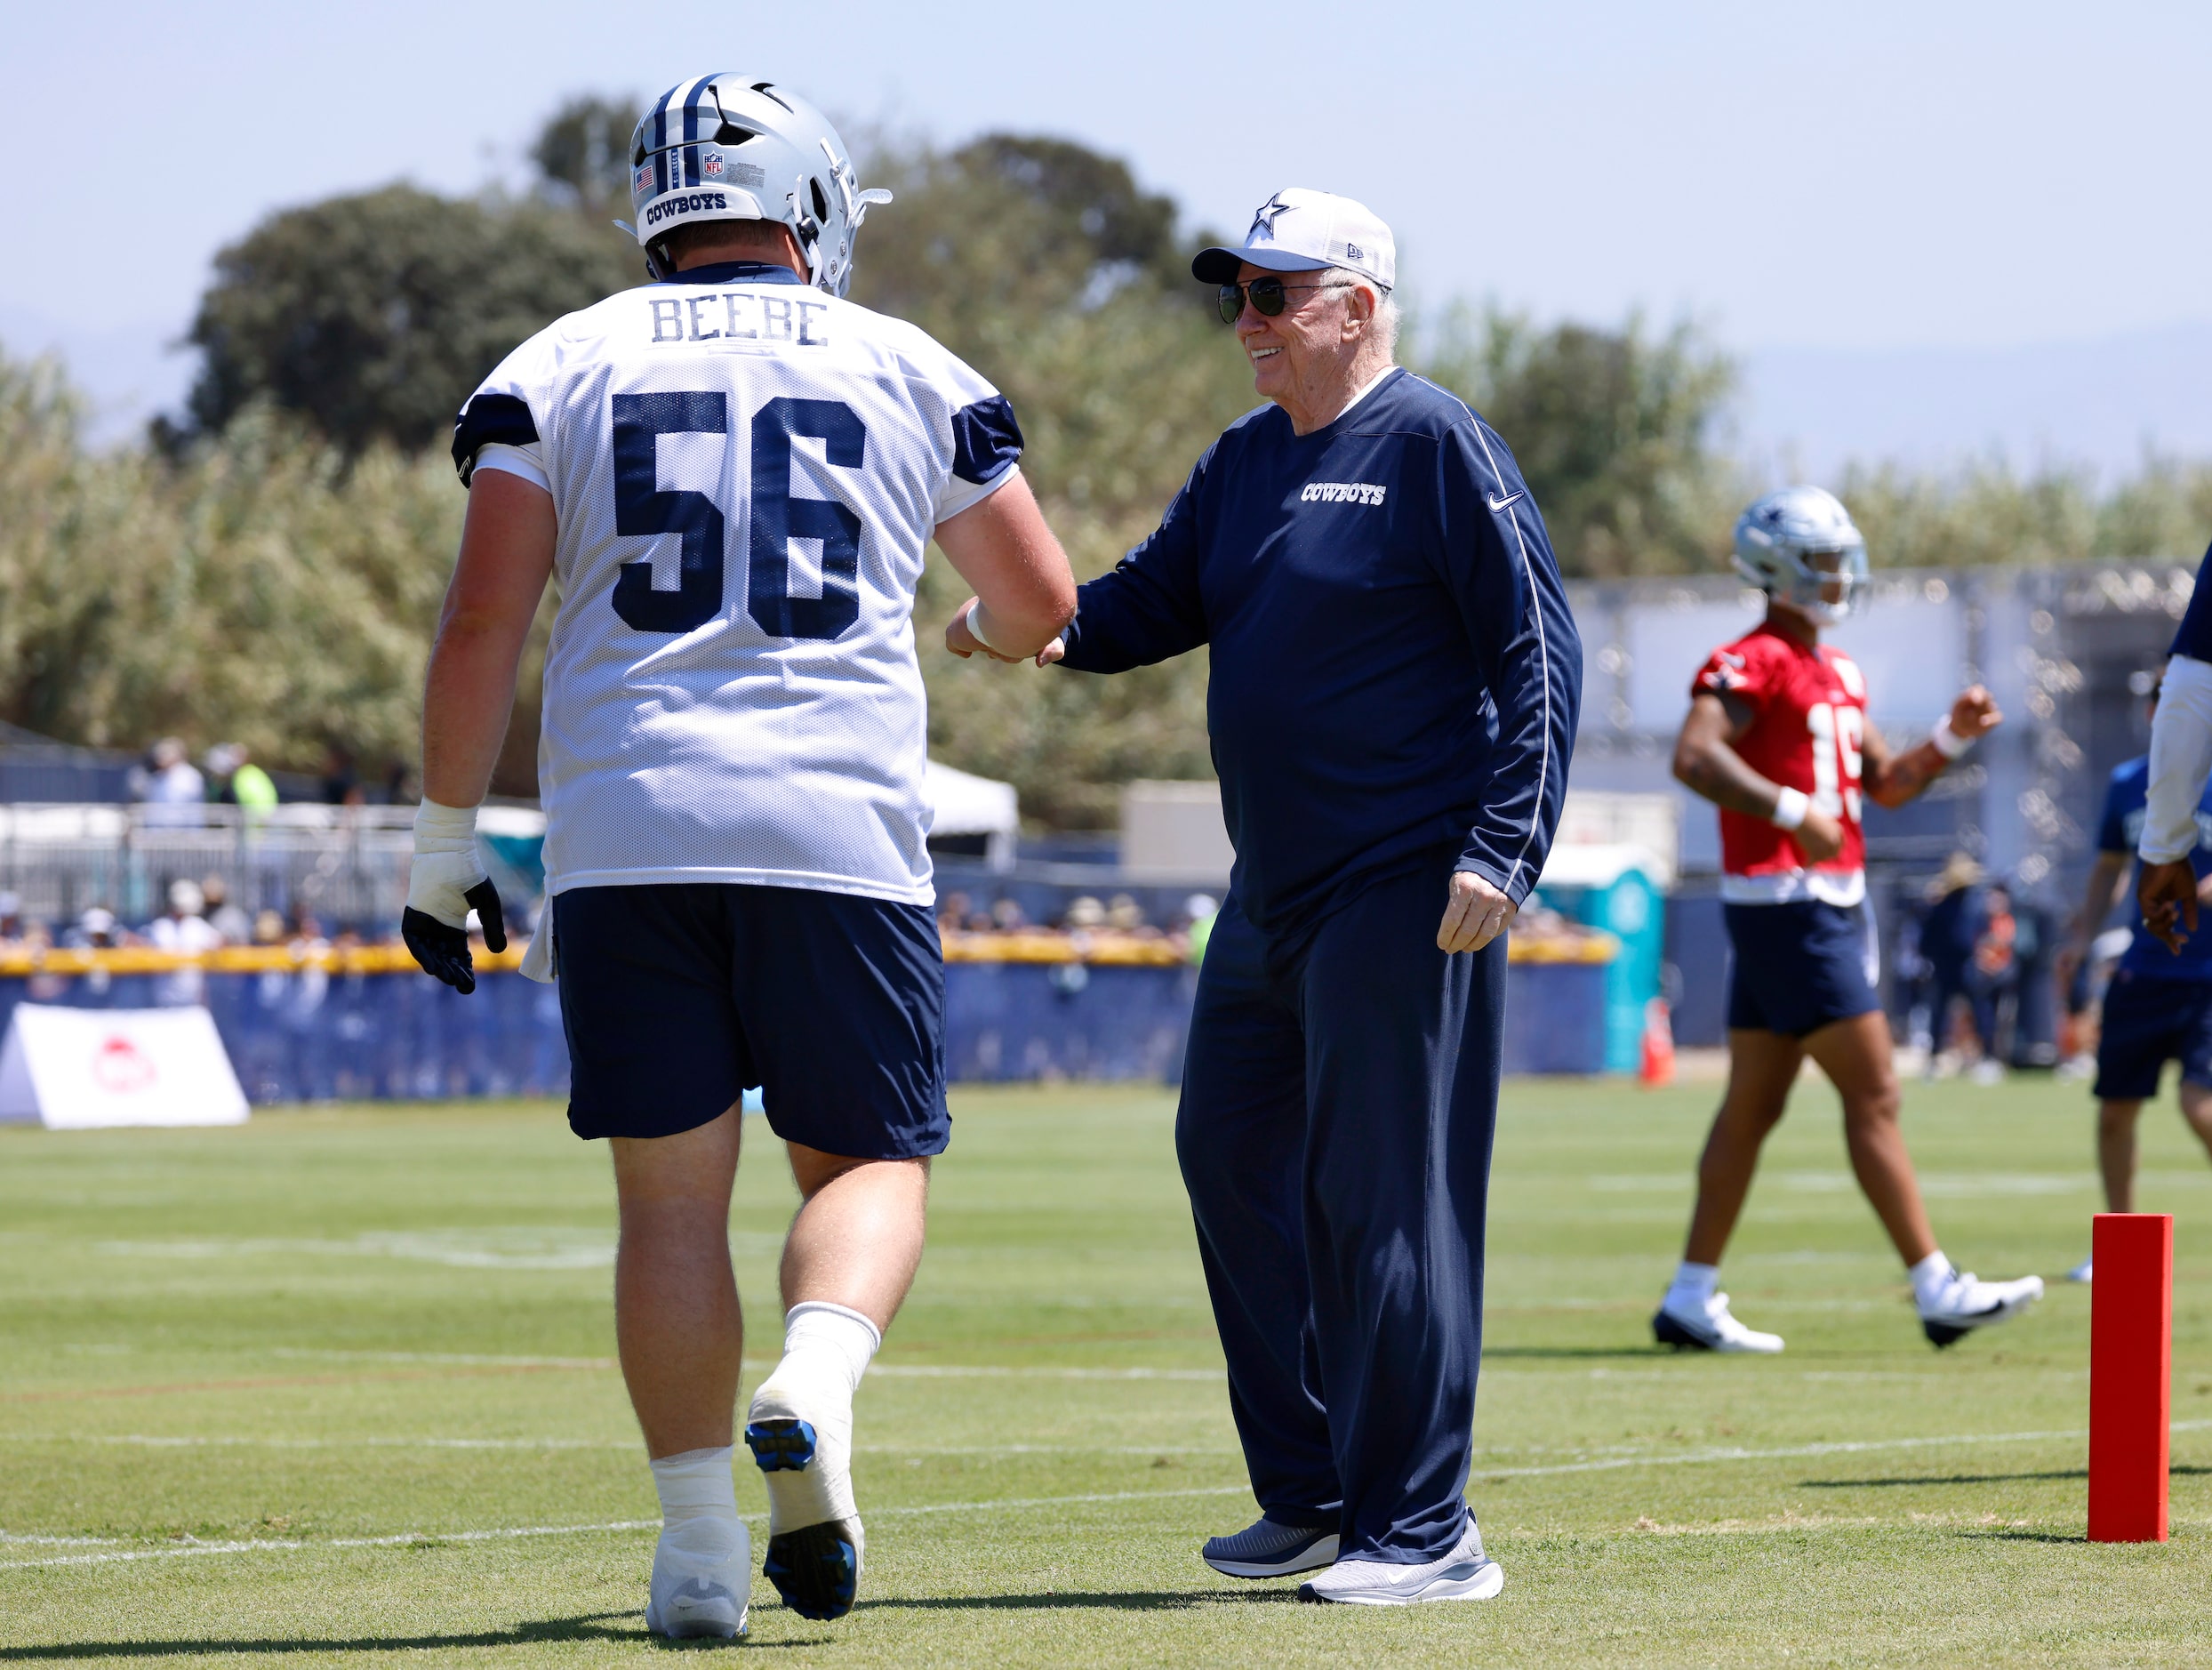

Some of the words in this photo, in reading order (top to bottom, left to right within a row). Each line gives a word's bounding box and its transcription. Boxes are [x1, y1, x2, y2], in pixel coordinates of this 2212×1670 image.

[706, 163, 722, 173] NFL
[646, 193, 727, 226] COWBOYS
[648, 293, 829, 347] BEEBE
[1301, 482, 1387, 506] COWBOYS
[612, 391, 866, 640] 56
